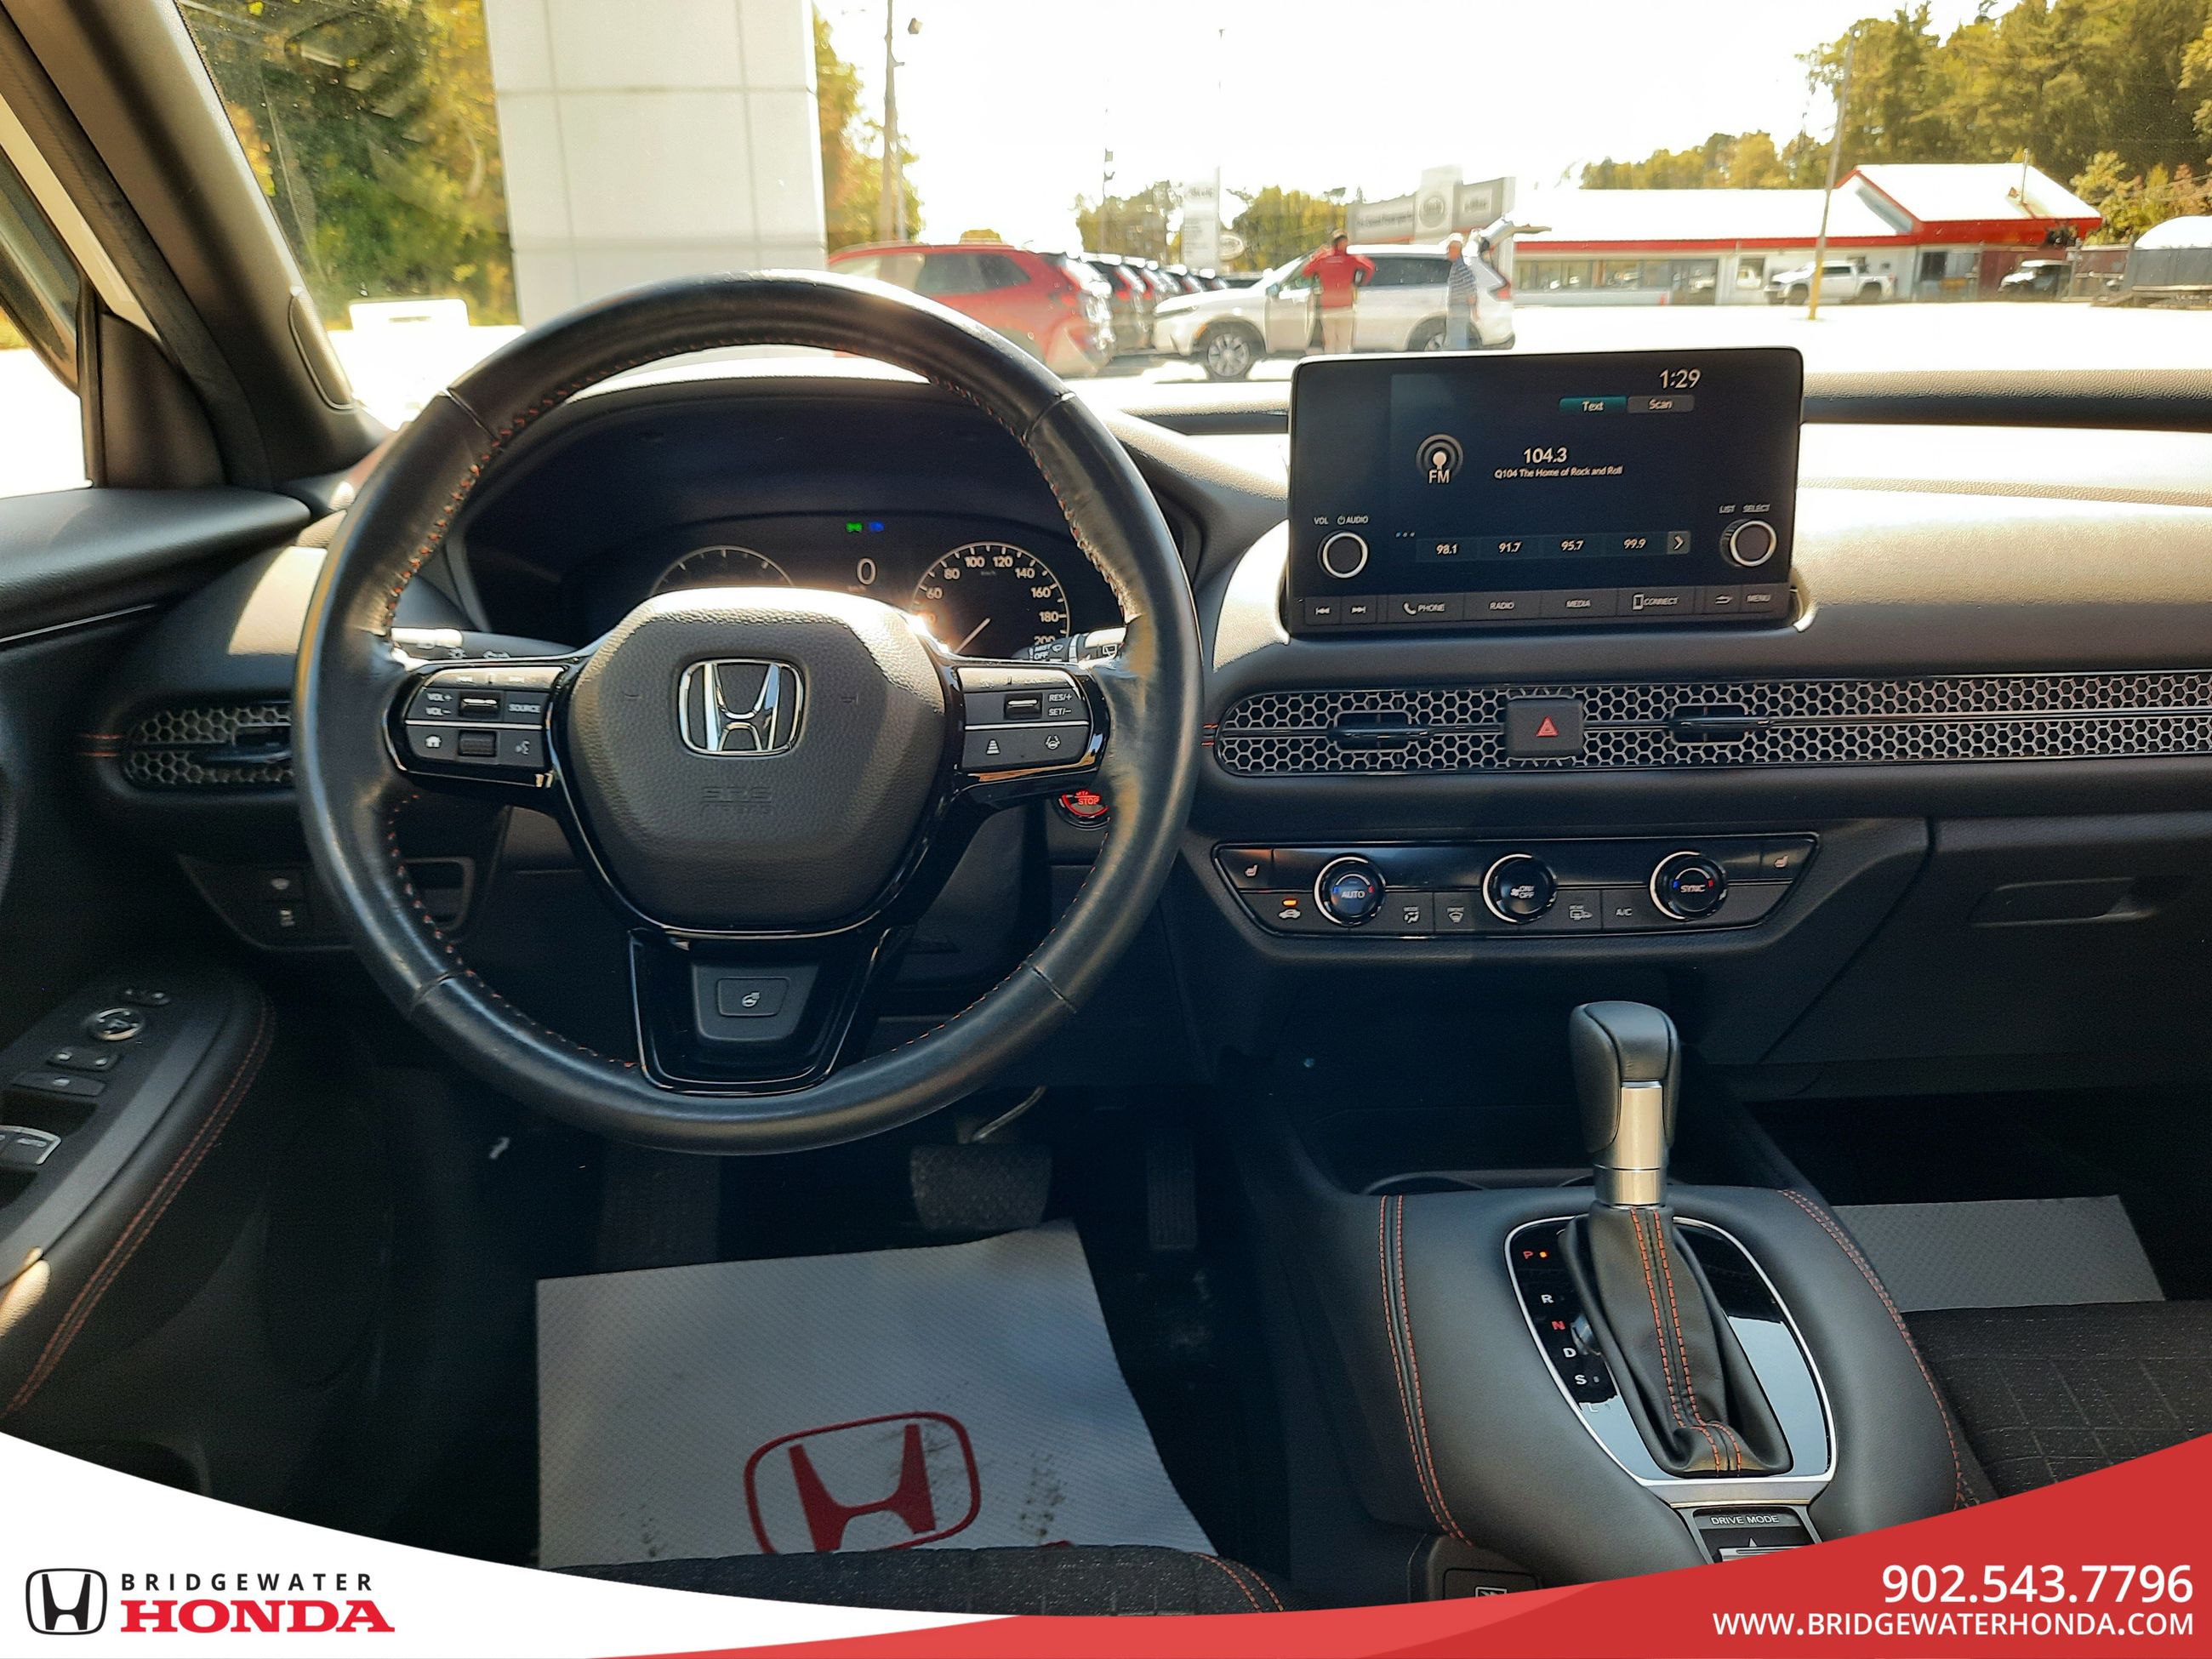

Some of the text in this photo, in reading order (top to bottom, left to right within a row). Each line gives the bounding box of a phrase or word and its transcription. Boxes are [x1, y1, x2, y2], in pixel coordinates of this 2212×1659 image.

[1660, 368, 1702, 390] 1:29
[1582, 402, 1605, 412] Text
[1649, 399, 1673, 410] Scan
[1523, 448, 1567, 464] 104.3
[1428, 470, 1450, 484] FM
[1494, 469, 1519, 479] Q104
[1519, 468, 1534, 478] The
[1535, 467, 1559, 477] Home
[1560, 467, 1570, 476] of
[1571, 466, 1590, 476] Rock
[1591, 466, 1606, 476] and
[1314, 515, 1369, 526] VOL AUDIO
[1497, 541, 1521, 554] 91.7
[1560, 539, 1585, 551] 95.7
[1622, 537, 1647, 550] 99.9
[1435, 544, 1458, 555] 98.1
[965, 556, 985, 567] 100
[993, 556, 1013, 567] 120
[856, 557, 877, 586] 0
[944, 567, 961, 580] 80
[1015, 567, 1035, 579] 140
[926, 587, 944, 599] 60
[1031, 585, 1052, 598] 160
[1644, 596, 1679, 606] CONNECT
[1747, 594, 1771, 602] MENU
[1417, 602, 1445, 613] PHONE
[1489, 601, 1515, 610] RADIO
[1565, 600, 1591, 609] MEDIA
[1039, 610, 1060, 623] 180
[1048, 693, 1072, 703] RES/+
[509, 703, 541, 714] SOURCE
[1078, 797, 1100, 806] STOP
[1341, 889, 1366, 899] AUTO
[1616, 908, 1633, 917] A/C
[1523, 1250, 1533, 1259] P
[1541, 1293, 1554, 1305] R
[1551, 1320, 1565, 1331] N
[1562, 1348, 1576, 1358] D
[1574, 1374, 1588, 1385] S
[1710, 1514, 1779, 1526] DRIVE MODE
